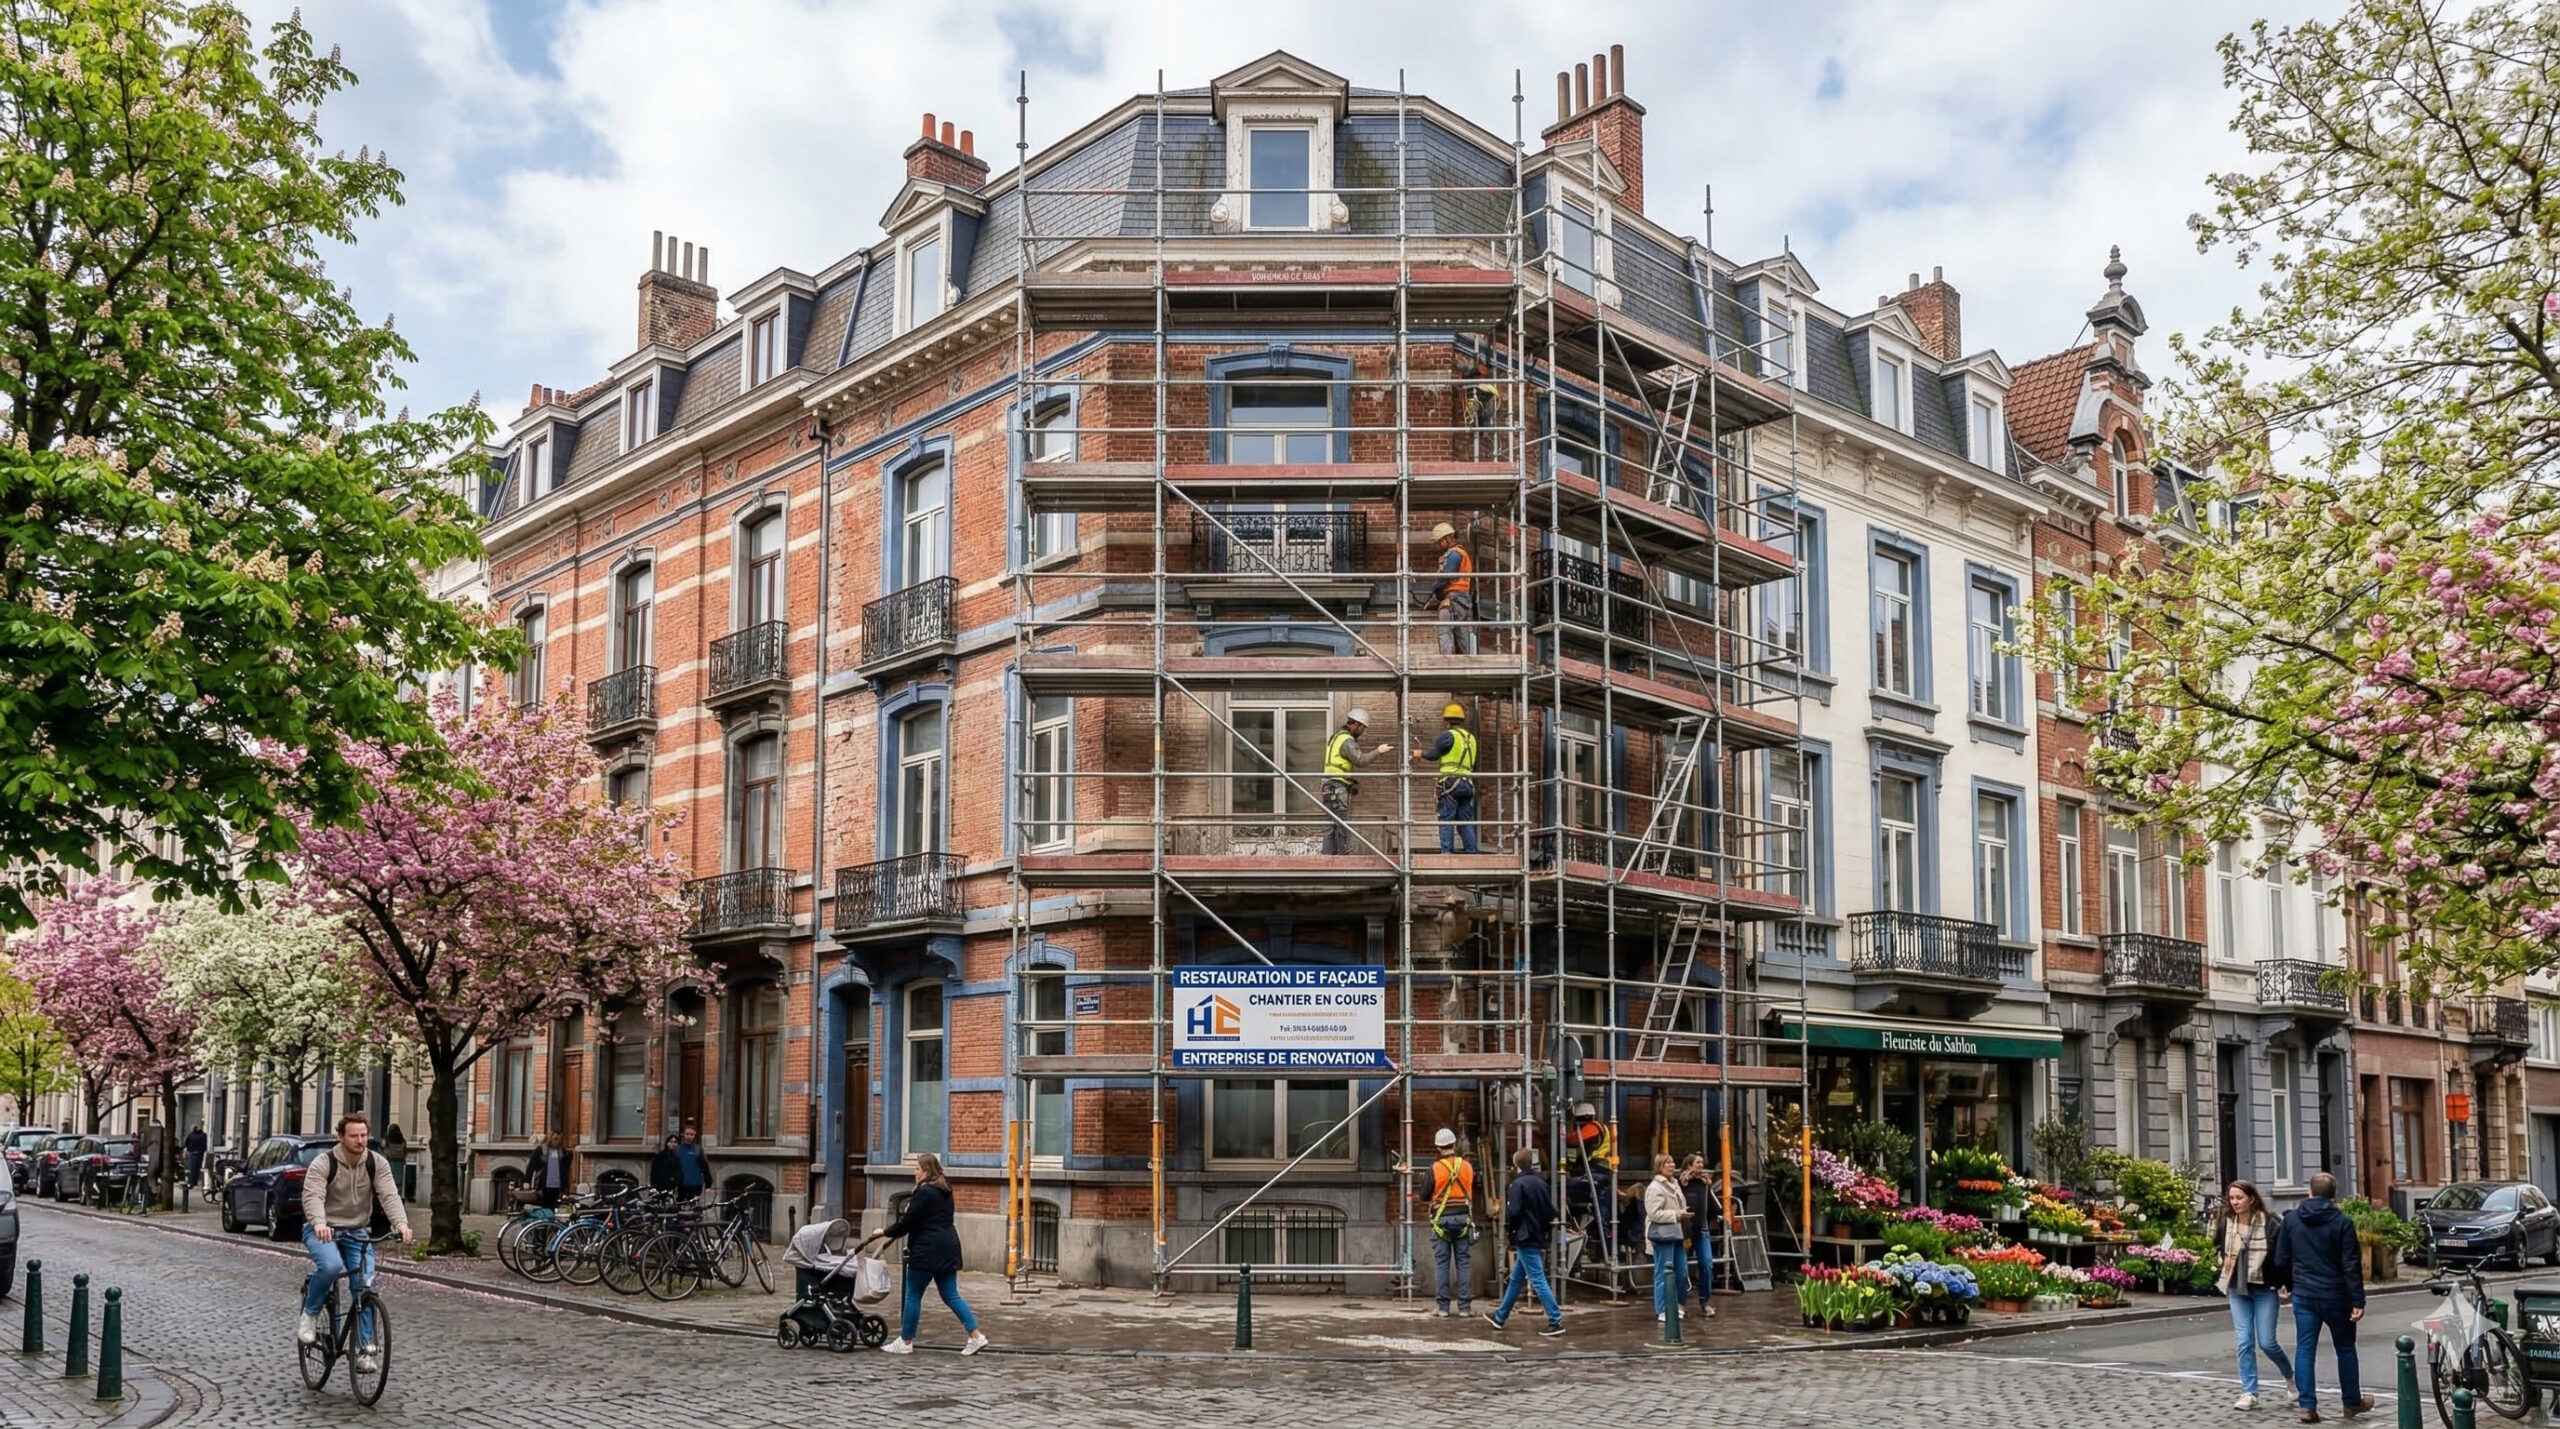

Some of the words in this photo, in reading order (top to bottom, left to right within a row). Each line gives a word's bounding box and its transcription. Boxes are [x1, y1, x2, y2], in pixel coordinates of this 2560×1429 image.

[1180, 970, 1291, 984] RESTAURATION
[1295, 970, 1316, 984] DE
[1319, 970, 1378, 988] FAÇADE
[1249, 994, 1312, 1006] CHANTIER
[1315, 994, 1332, 1006] EN
[1335, 994, 1378, 1006] COURS
[1881, 1031, 1927, 1051] Fleuriste
[1928, 1034, 1942, 1052] du
[1944, 1035, 1977, 1055] Sablon
[1181, 1052, 1266, 1065] ENTREPRISE
[1268, 1052, 1287, 1065] DE
[1290, 1052, 1376, 1065] RENOVATION
